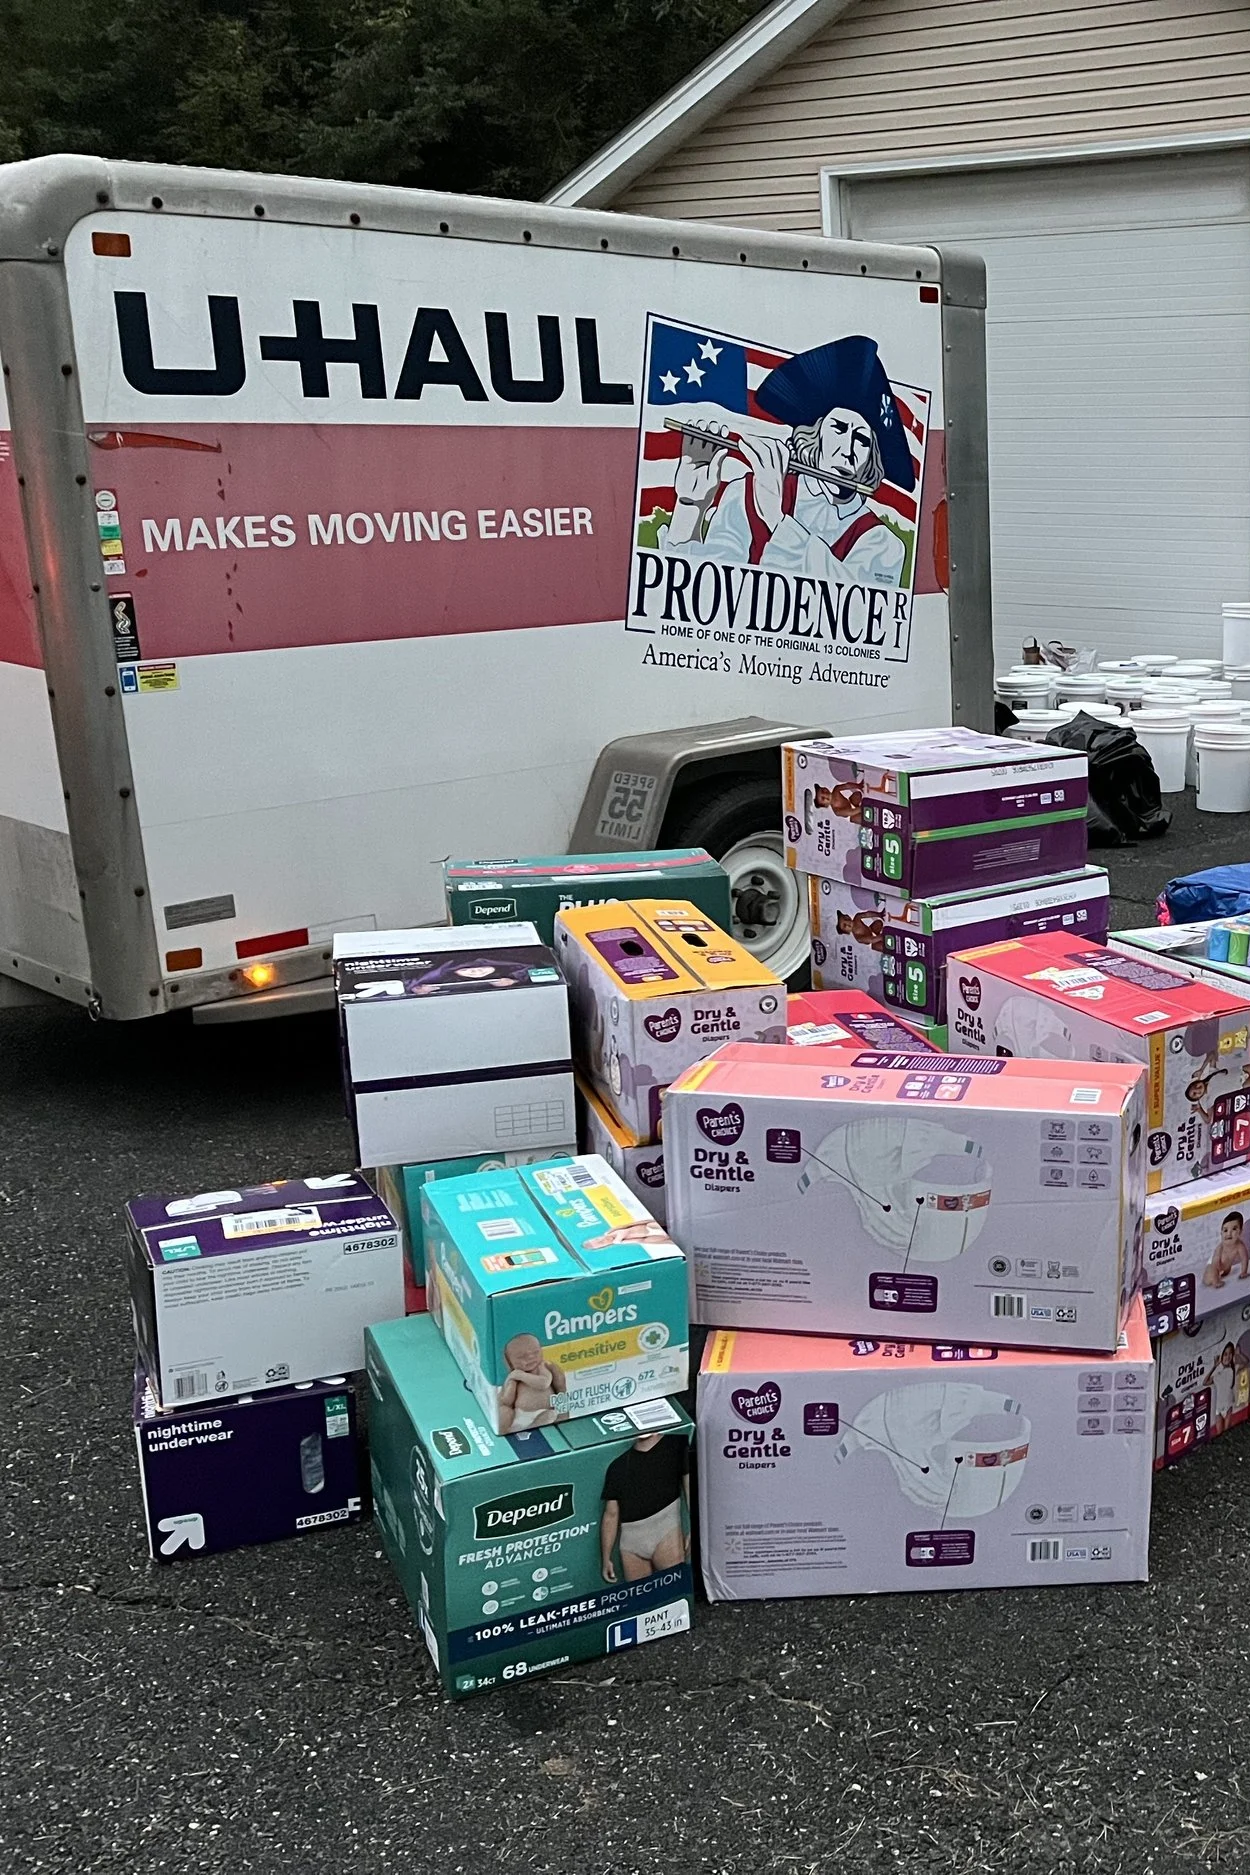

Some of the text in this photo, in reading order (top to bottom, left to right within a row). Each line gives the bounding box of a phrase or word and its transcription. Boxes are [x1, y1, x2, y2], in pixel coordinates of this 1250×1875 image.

[113, 290, 634, 405] U-HAUL
[142, 514, 297, 552] MAKES
[308, 509, 467, 546] MOVING
[478, 506, 594, 540] EASIER
[632, 551, 888, 646] PROVIDENCE
[661, 624, 881, 660] HOME OF ONE OF THE ORIGINAL 13 COLONIES
[641, 643, 888, 688] America's Moving Adventure
[885, 838, 899, 855] 5
[475, 903, 512, 917] Depend
[344, 957, 421, 968] nighttime
[344, 960, 432, 971] underwear
[908, 966, 924, 983] 5
[648, 1013, 679, 1031] Parent's
[693, 1006, 737, 1023] Dry &
[957, 1007, 984, 1030] Dry &
[690, 1019, 741, 1035] Gentle
[955, 1021, 986, 1045] Gentle
[702, 1034, 730, 1043] Diapers
[703, 1110, 741, 1128] Parent's
[1236, 1118, 1249, 1130] 7
[710, 1126, 738, 1138] CHOICE
[1185, 1115, 1196, 1162] Gentle
[693, 1147, 750, 1168] Dry &
[1176, 1136, 1187, 1161] Dry
[690, 1163, 755, 1182] Gentle
[704, 1182, 741, 1194] Diapers
[308, 1219, 393, 1237] nighttime
[320, 1213, 390, 1229] underw
[345, 1236, 395, 1253] 4678302
[1152, 1233, 1180, 1251] Dry &
[1149, 1244, 1183, 1262] Gentle
[544, 1303, 638, 1340] Pampers
[1030, 1308, 1044, 1317] USA
[1157, 1315, 1169, 1334] 3
[559, 1340, 627, 1364] sensitive
[638, 1369, 655, 1382] 672
[1175, 1365, 1205, 1389] Gentle
[1178, 1363, 1195, 1377] Dry
[566, 1388, 583, 1401] NOT
[585, 1382, 611, 1398] FLUSH
[737, 1390, 778, 1409] Parent's
[325, 1403, 347, 1412] L/XL
[570, 1401, 585, 1411] PAS
[587, 1394, 611, 1408] JETER
[746, 1403, 775, 1417] CHOICE
[147, 1418, 223, 1441] nighttime
[728, 1427, 786, 1446] Dry &
[1182, 1425, 1192, 1444] 7
[148, 1428, 234, 1453] underwear
[722, 1443, 792, 1459] Gentle
[738, 1460, 777, 1470] Diapers
[296, 1509, 348, 1527] 4678302
[486, 1493, 564, 1528] Depend
[458, 1522, 591, 1567] FRESH PROTECTION
[484, 1541, 562, 1571] ADVANCED
[1066, 1550, 1080, 1558] USA
[474, 1569, 683, 1642] 100% LEAK-FREE PROTECTION
[536, 1604, 621, 1636] ULTIMATE ABSORBENCY
[644, 1609, 670, 1627] PANT
[614, 1625, 633, 1648] L
[644, 1617, 683, 1638] 35-43 in
[502, 1655, 570, 1680] 68 UNDERWEAR
